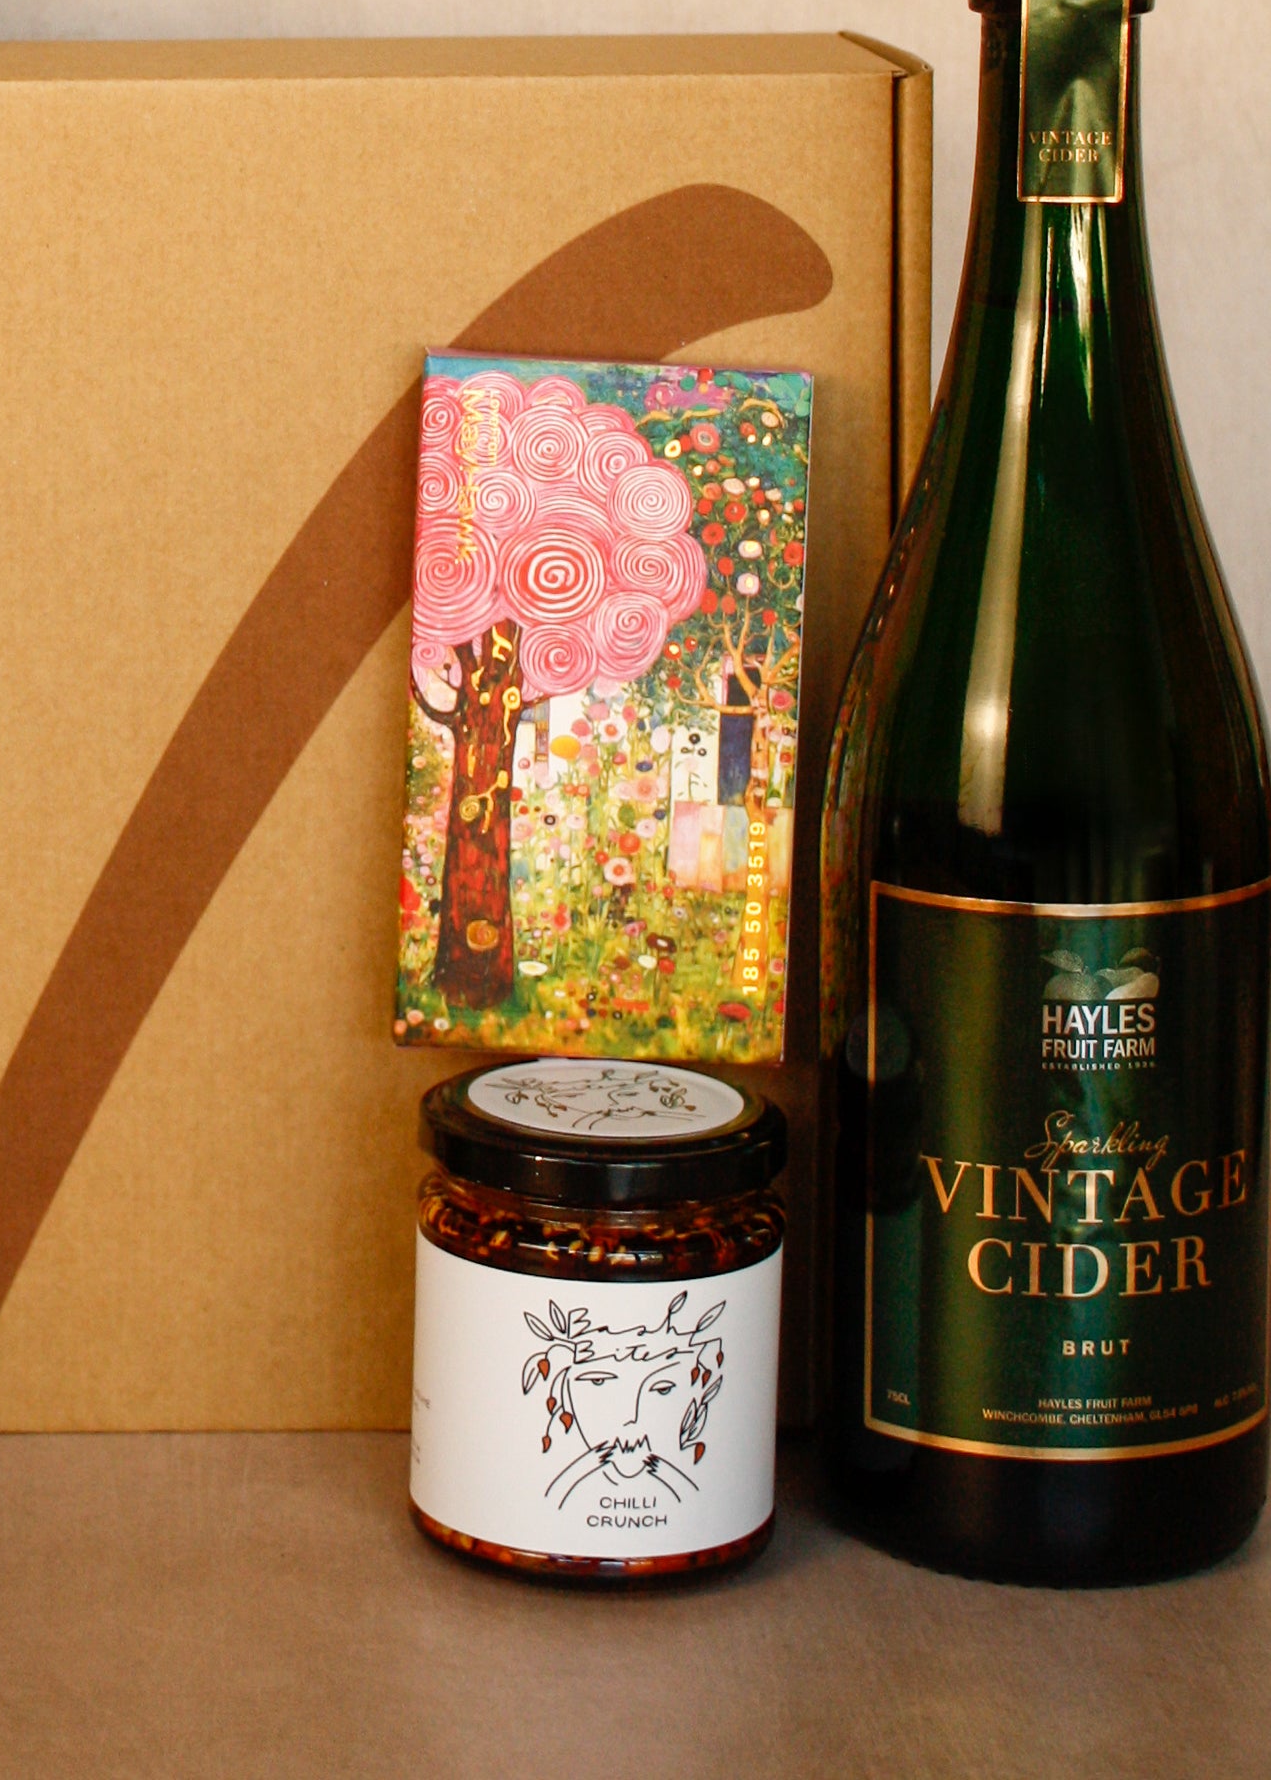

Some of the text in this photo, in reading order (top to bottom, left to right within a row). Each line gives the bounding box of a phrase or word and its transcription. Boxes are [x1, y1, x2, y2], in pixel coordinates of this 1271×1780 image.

[1028, 130, 1113, 146] VINTAGE
[1039, 147, 1100, 163] CIDER
[742, 822, 766, 996] 185 50 3519
[1042, 1002, 1156, 1035] HAYLES
[1042, 1037, 1155, 1059] FRUIT FARM
[1042, 1062, 1121, 1071] ESTABLISHED
[1024, 1109, 1170, 1170] Sparkling
[919, 1148, 1249, 1224] VINTAGE
[967, 1234, 1213, 1299] CIDER
[1063, 1339, 1131, 1356] BRUT
[1038, 1395, 1152, 1410] HAYLES FRUIT FARM
[599, 1496, 657, 1509] CHILLI
[586, 1514, 668, 1529] CRUNCH
